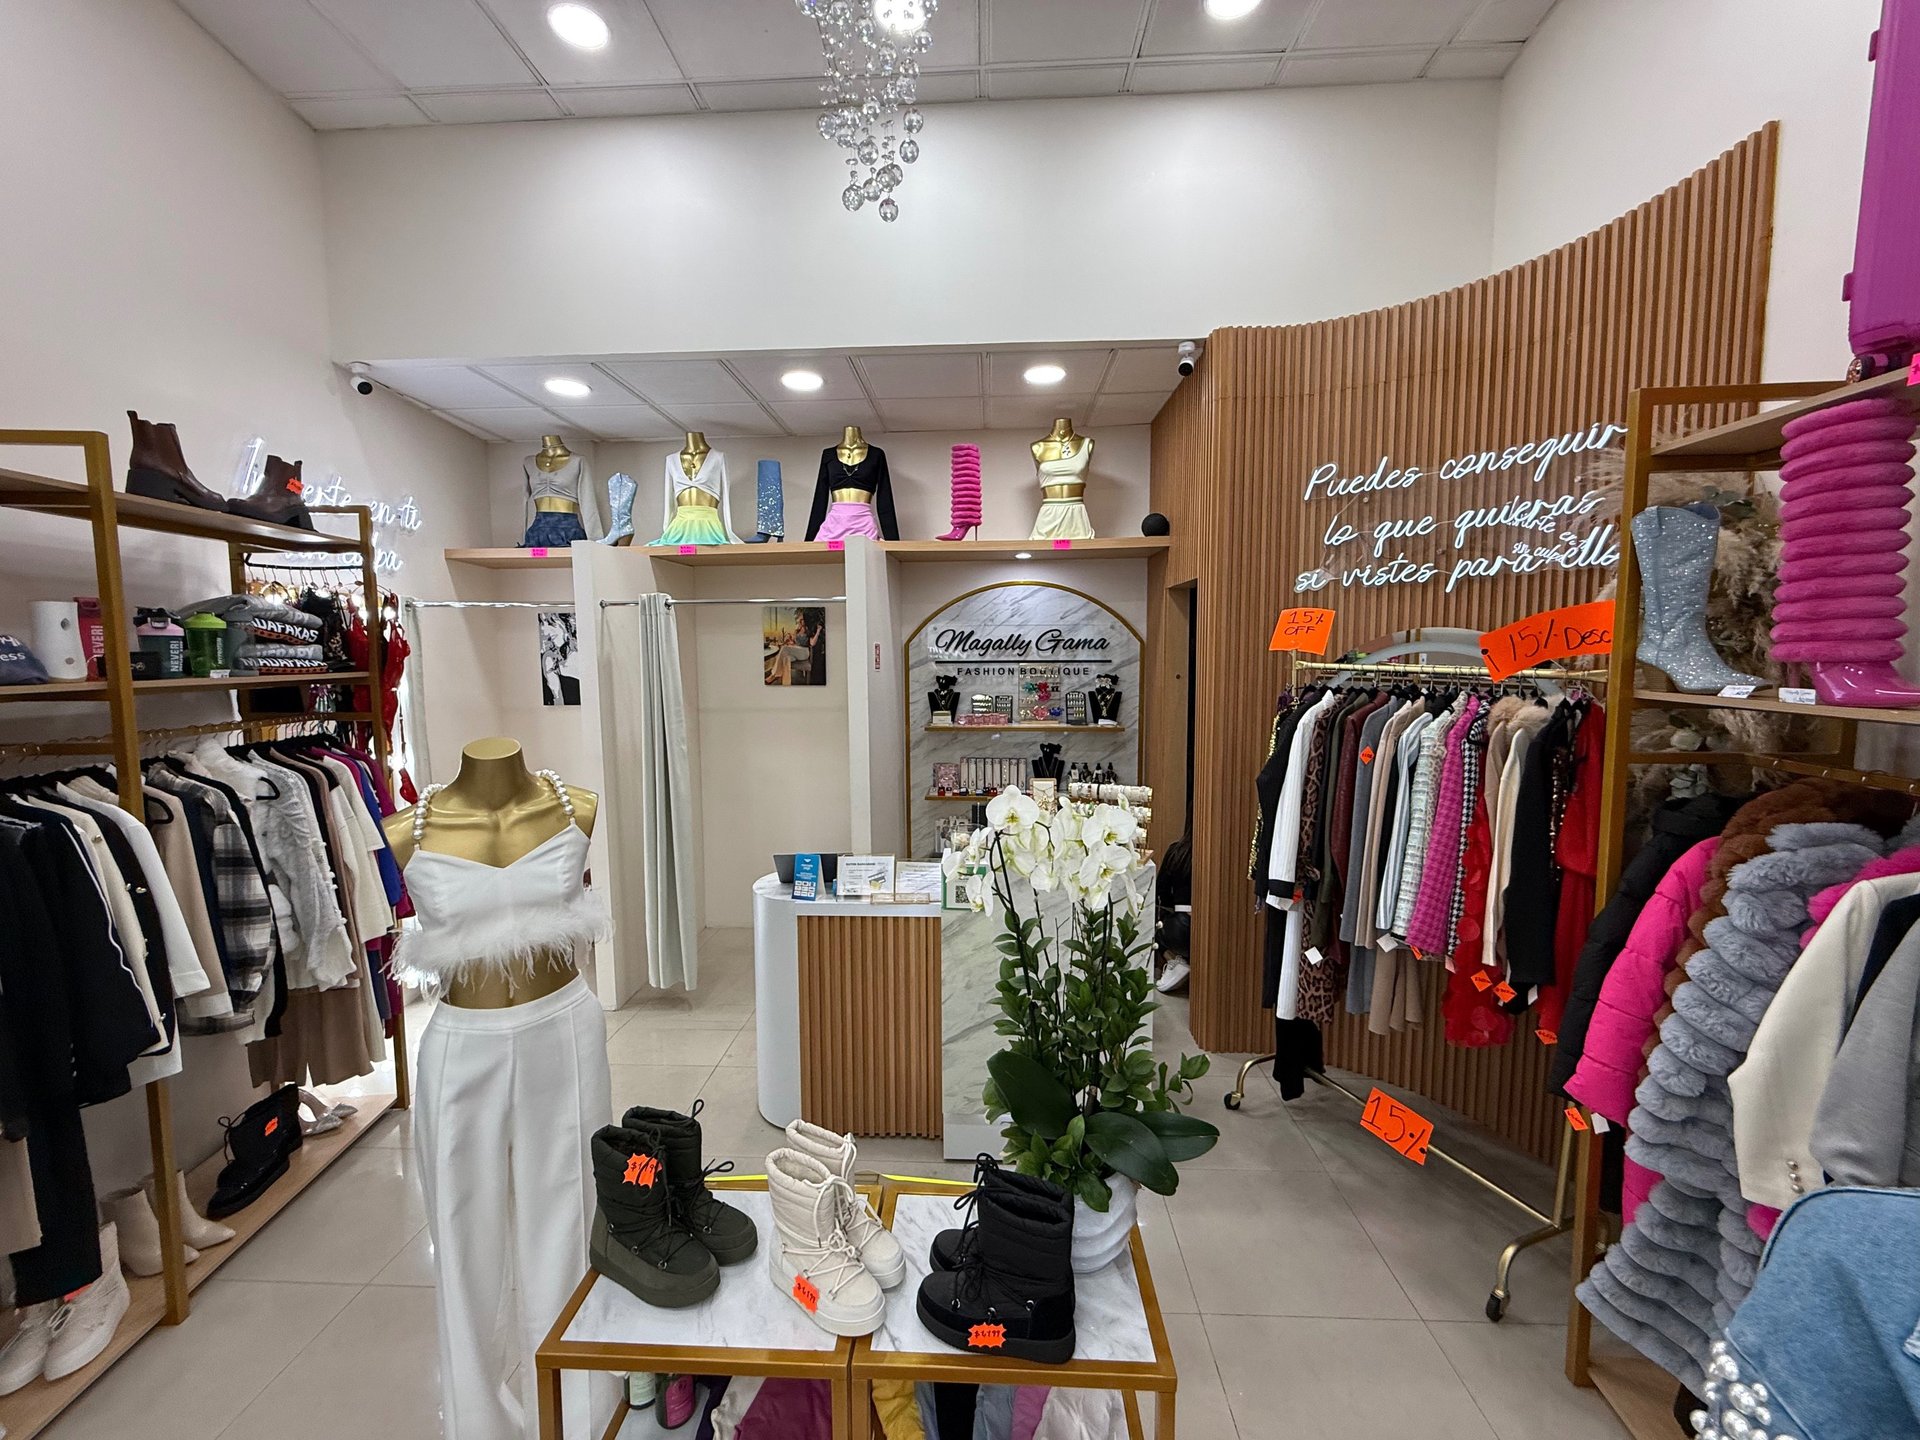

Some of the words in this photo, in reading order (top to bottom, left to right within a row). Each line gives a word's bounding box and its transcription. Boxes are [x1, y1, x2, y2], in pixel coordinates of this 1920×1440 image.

[1303, 456, 1424, 501] Puedes
[1439, 422, 1629, 482] conseguir
[1324, 515, 1360, 546] lo
[1373, 515, 1438, 558] que
[1454, 490, 1606, 549] quieras
[1295, 568, 1327, 591] si
[1342, 552, 1439, 587] vistes
[1445, 554, 1544, 594] para
[1561, 524, 1620, 568] ello
[1284, 625, 1316, 636] OFF
[1287, 610, 1324, 625] 15%
[935, 629, 1032, 656] Magally
[1035, 629, 1110, 655] Gama
[957, 667, 1015, 676] FASHION
[1361, 1096, 1427, 1155] 15%
